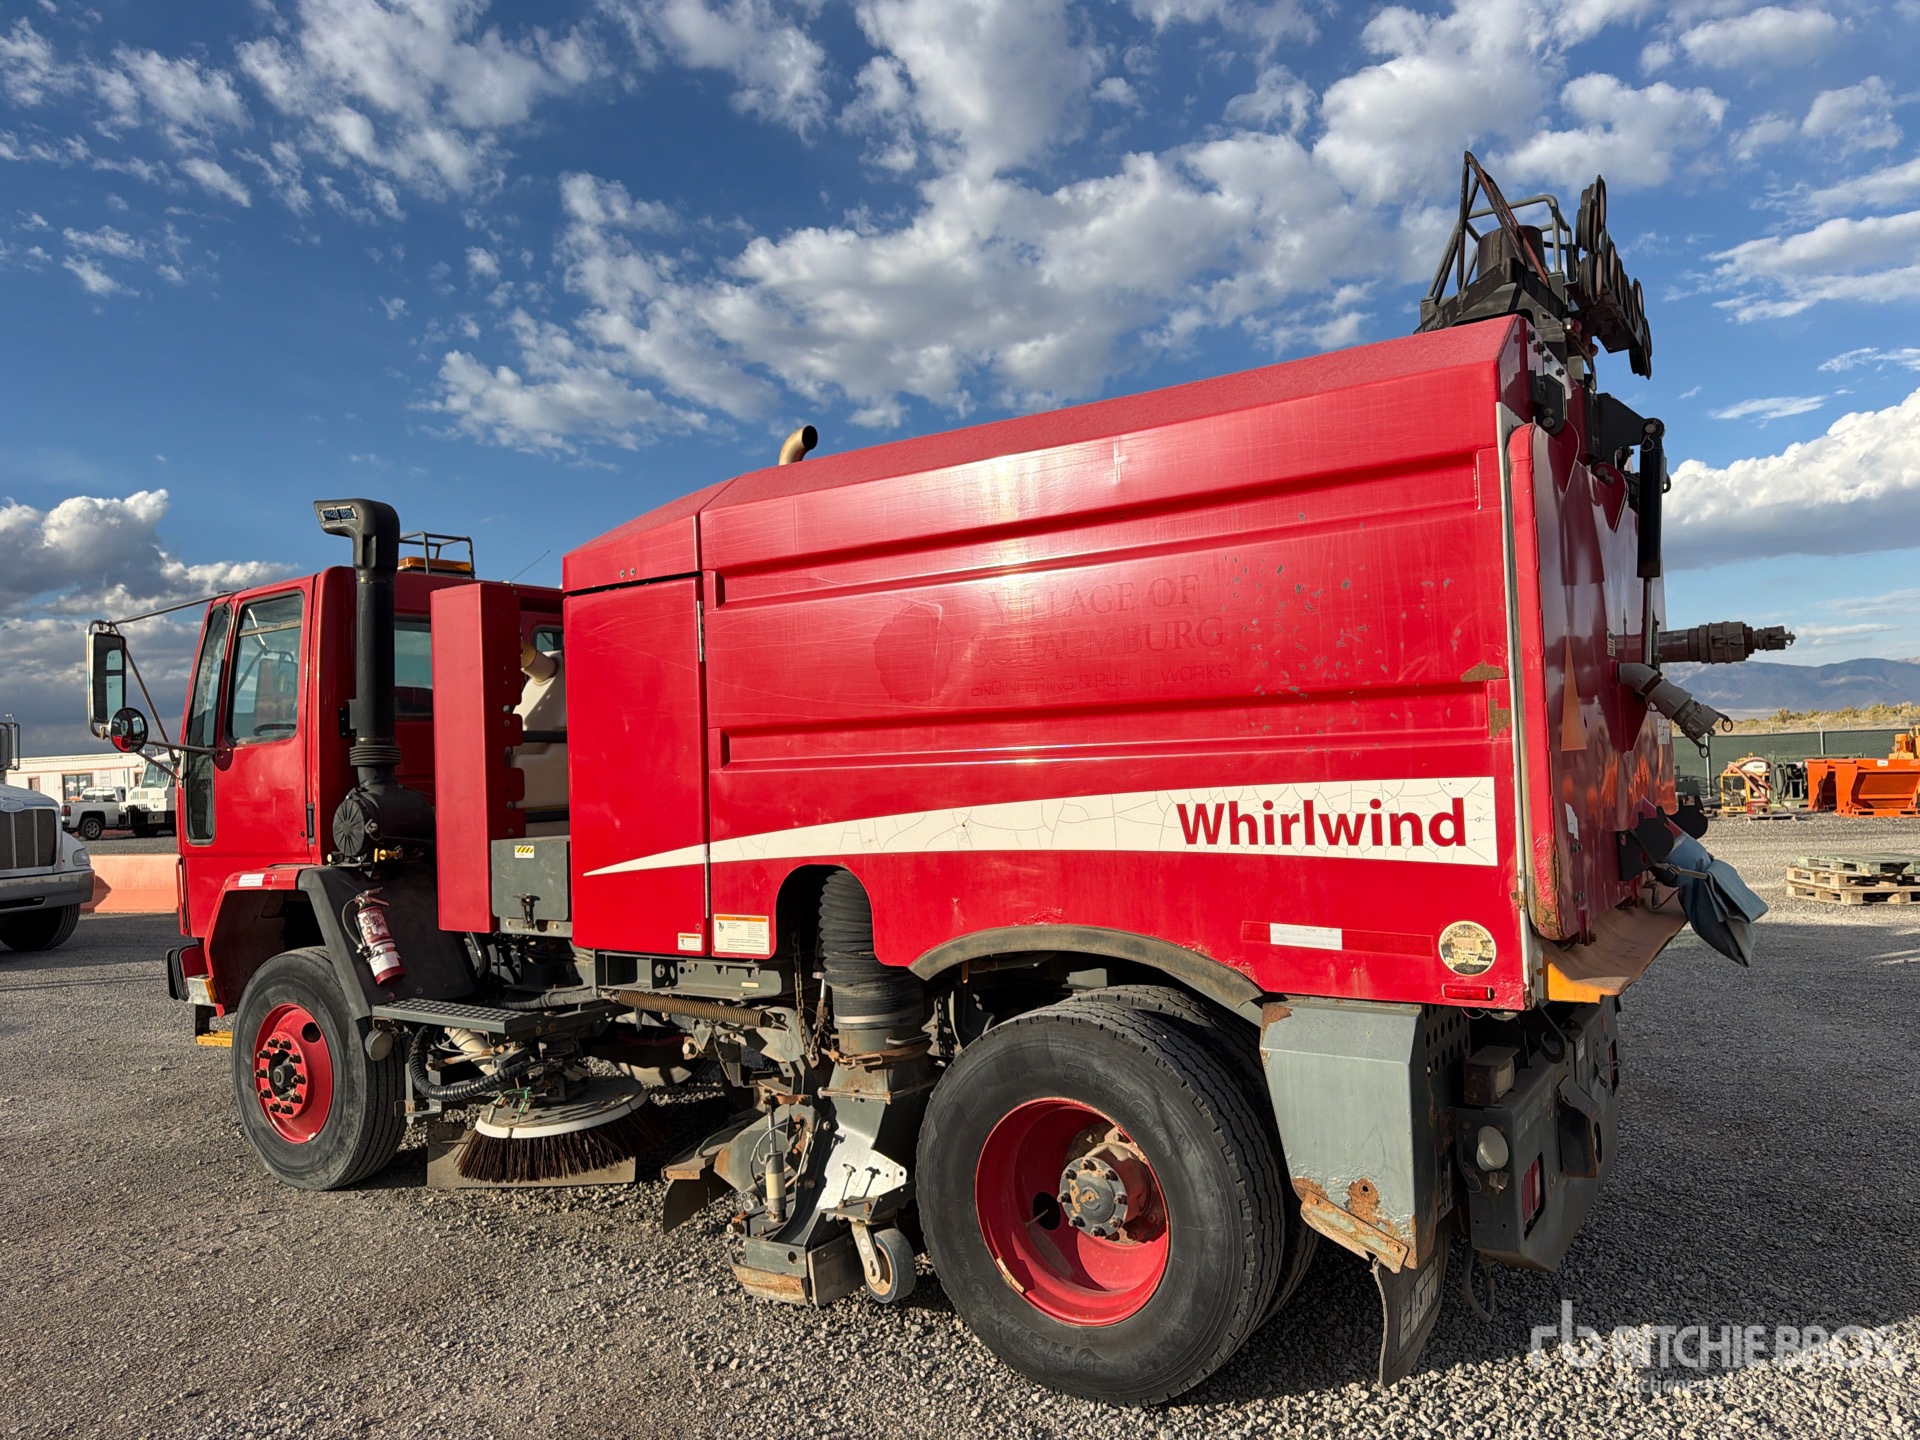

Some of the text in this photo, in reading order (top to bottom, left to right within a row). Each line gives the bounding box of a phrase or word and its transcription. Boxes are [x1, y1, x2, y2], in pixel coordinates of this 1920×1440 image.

[1148, 574, 1200, 608] OF
[1161, 663, 1232, 682] WORKS
[1176, 798, 1467, 847] Whirlwind
